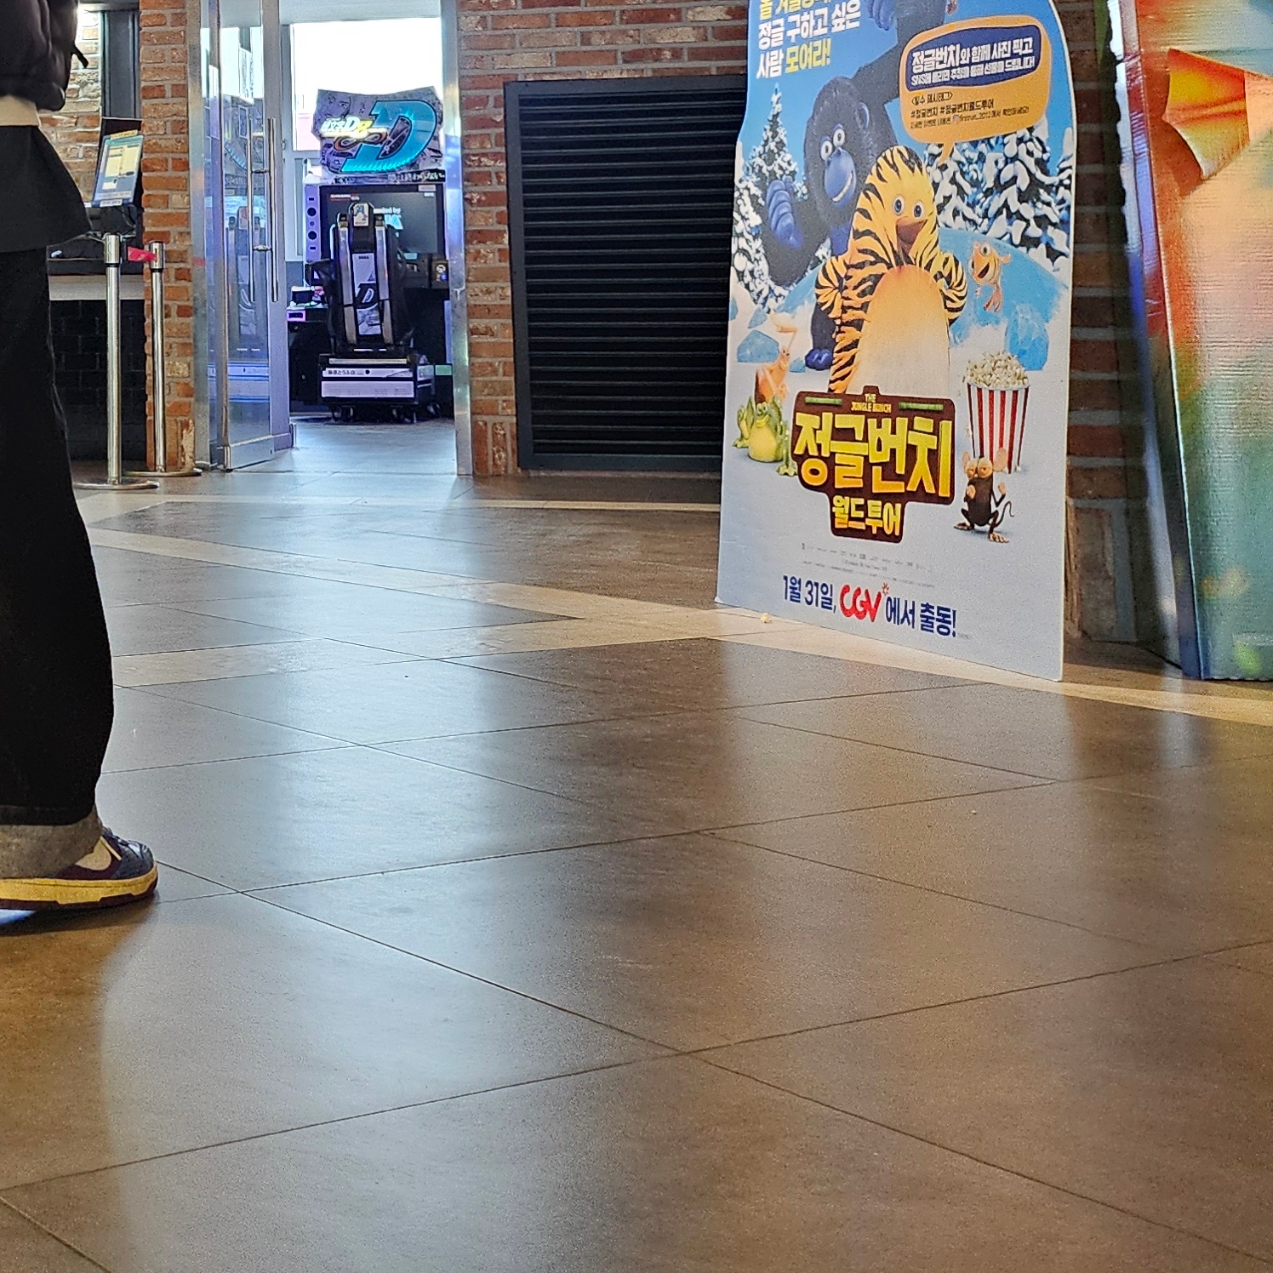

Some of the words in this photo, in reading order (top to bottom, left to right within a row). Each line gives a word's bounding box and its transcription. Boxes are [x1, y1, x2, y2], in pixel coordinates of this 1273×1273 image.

[758, 18, 785, 50] 정글
[787, 7, 829, 43] 구하고
[756, 48, 784, 79] 사람
[785, 38, 832, 73] 모여라!
[971, 44, 991, 63] 함께
[991, 40, 1011, 60] 사진
[1012, 37, 1034, 56] 찍고
[851, 401, 873, 412] JUNGLE
[864, 393, 876, 403] THE
[794, 412, 953, 498] 정글번치
[832, 494, 902, 536] 월드투어
[782, 575, 802, 604] 1월
[804, 580, 837, 613] 31일,
[839, 584, 881, 622] CGV
[885, 596, 916, 629] 에서
[919, 601, 957, 638] 출동!
